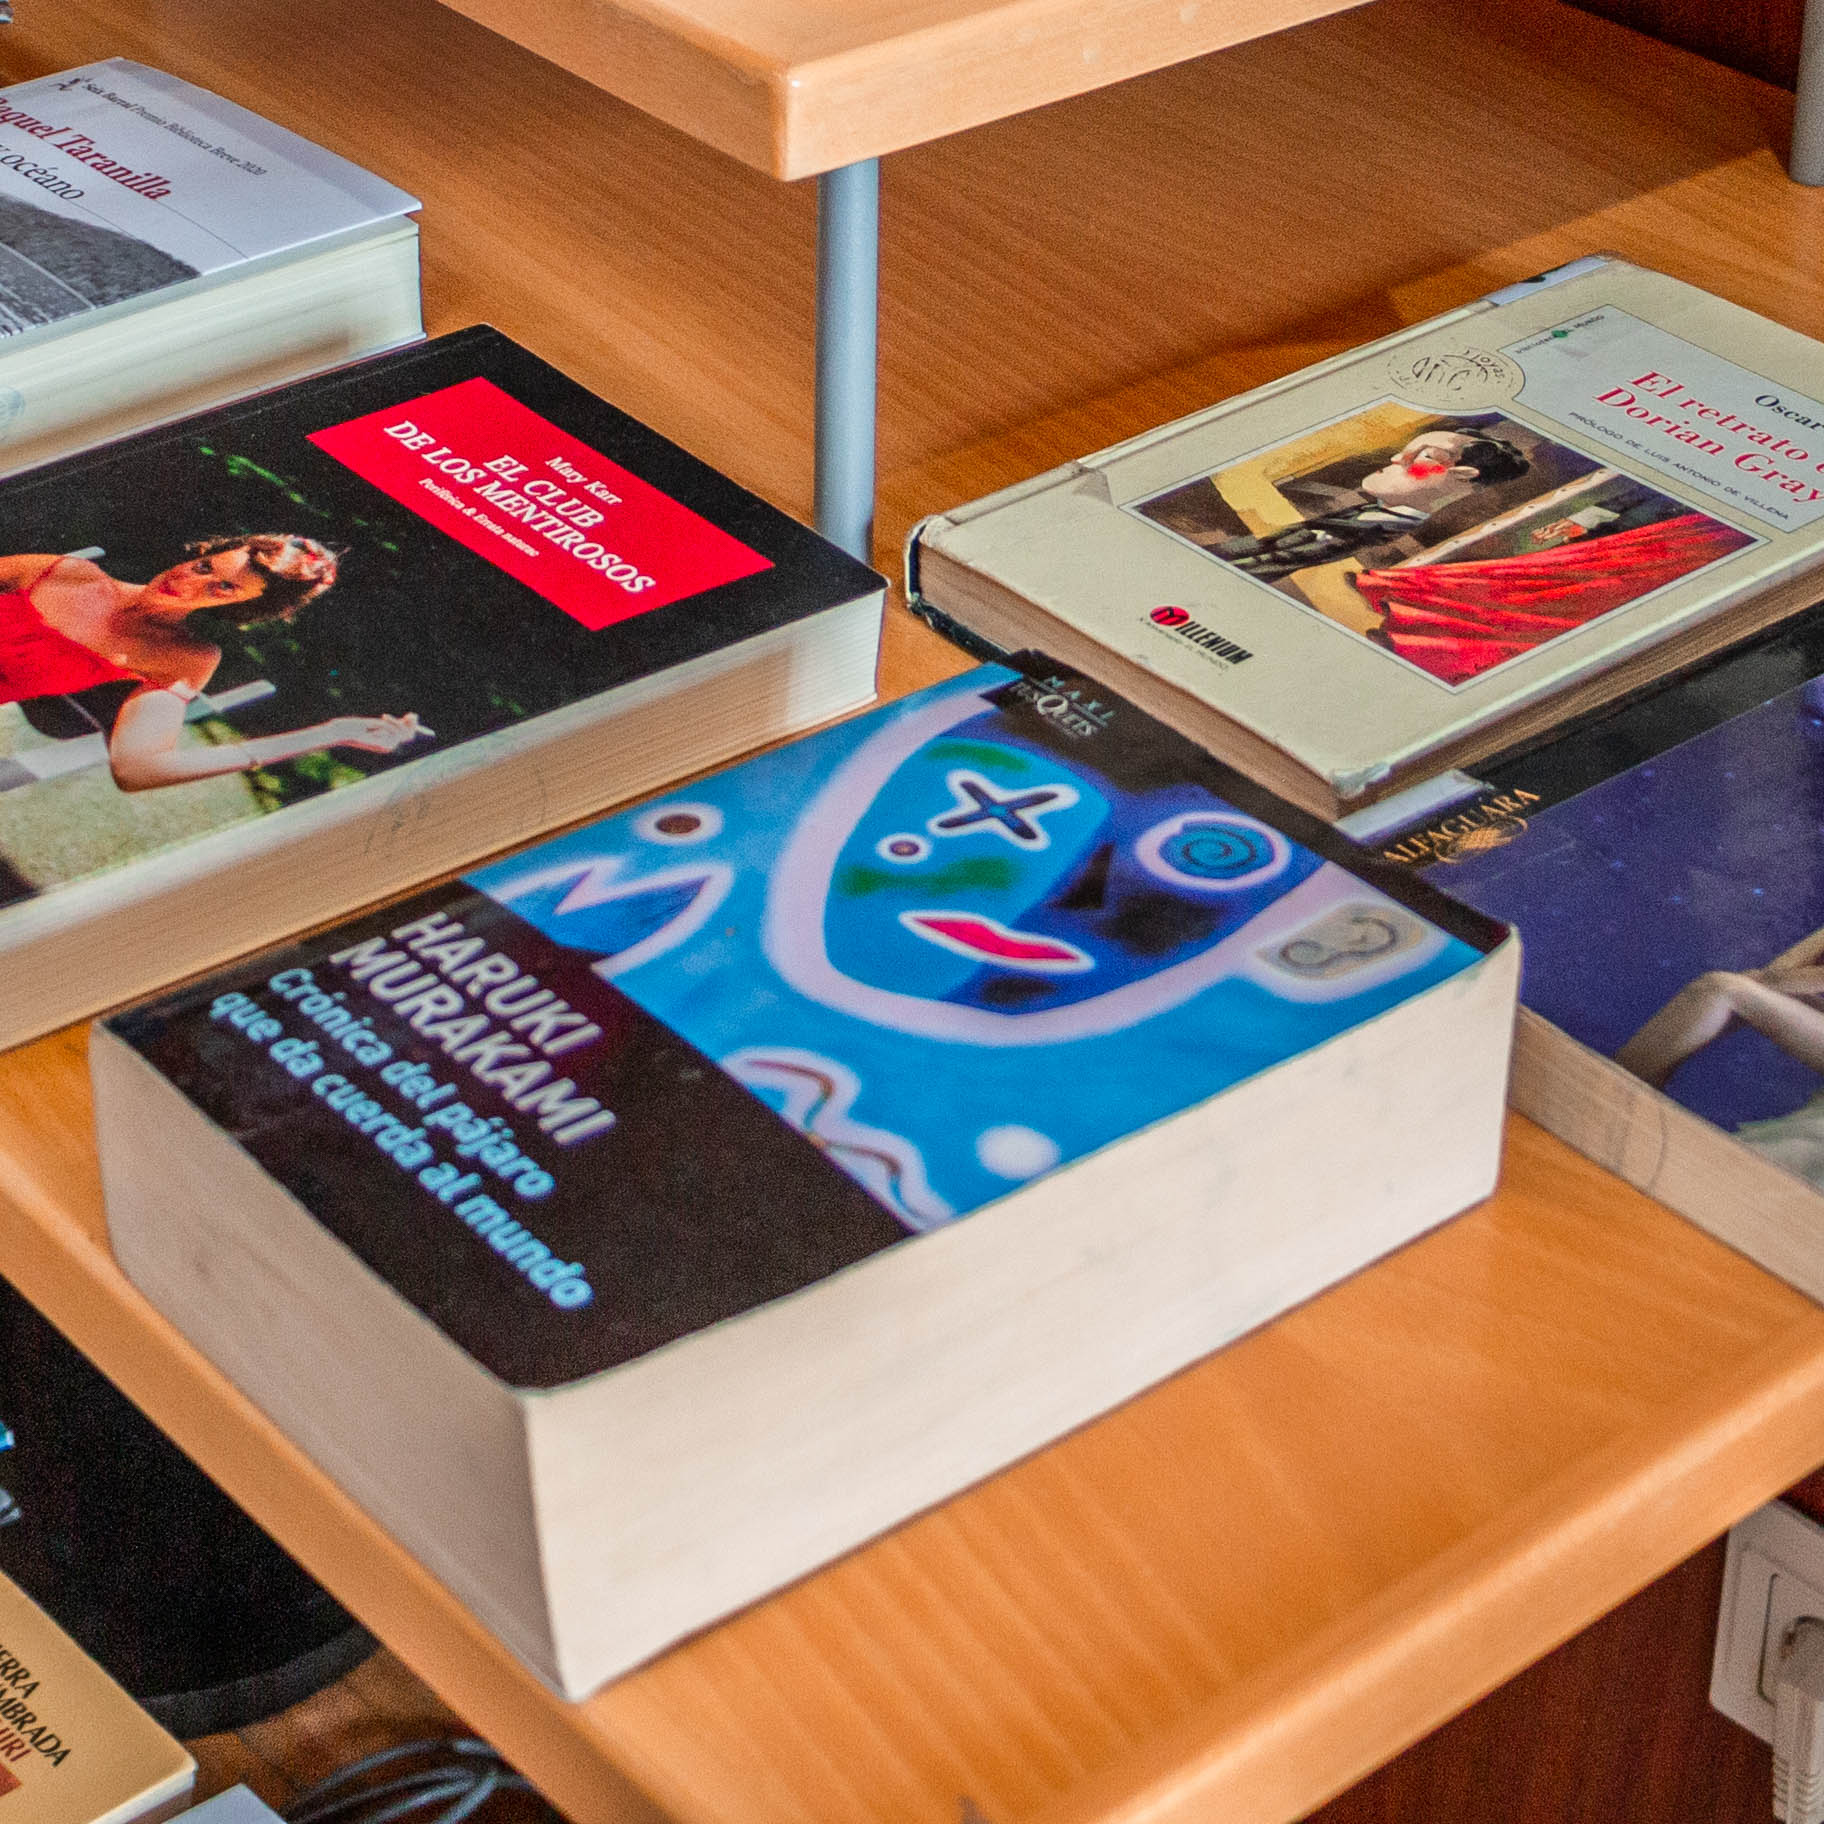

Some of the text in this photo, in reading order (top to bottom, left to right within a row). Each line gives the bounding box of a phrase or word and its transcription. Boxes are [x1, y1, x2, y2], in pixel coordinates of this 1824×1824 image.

[54, 126, 174, 203] Taranilla
[1593, 385, 1727, 457] Dorian
[1626, 370, 1684, 402] El
[1678, 396, 1811, 463] retrato
[381, 419, 657, 596] DE LOS MENTIROSOS
[481, 453, 606, 531] EL CLUB
[544, 455, 625, 507] Mary Karr
[1625, 437, 1644, 451] DE
[1644, 445, 1673, 466] LUIS
[1674, 461, 1723, 489] ANTONIO
[1723, 484, 1741, 498] DE
[1383, 787, 1542, 864] ALFAGUARA
[390, 909, 604, 1056] HARUKI
[268, 965, 557, 1201] Crónica del pájaro
[327, 934, 619, 1149] MURAKAMI
[209, 989, 596, 1310] que da cuerda al mundo
